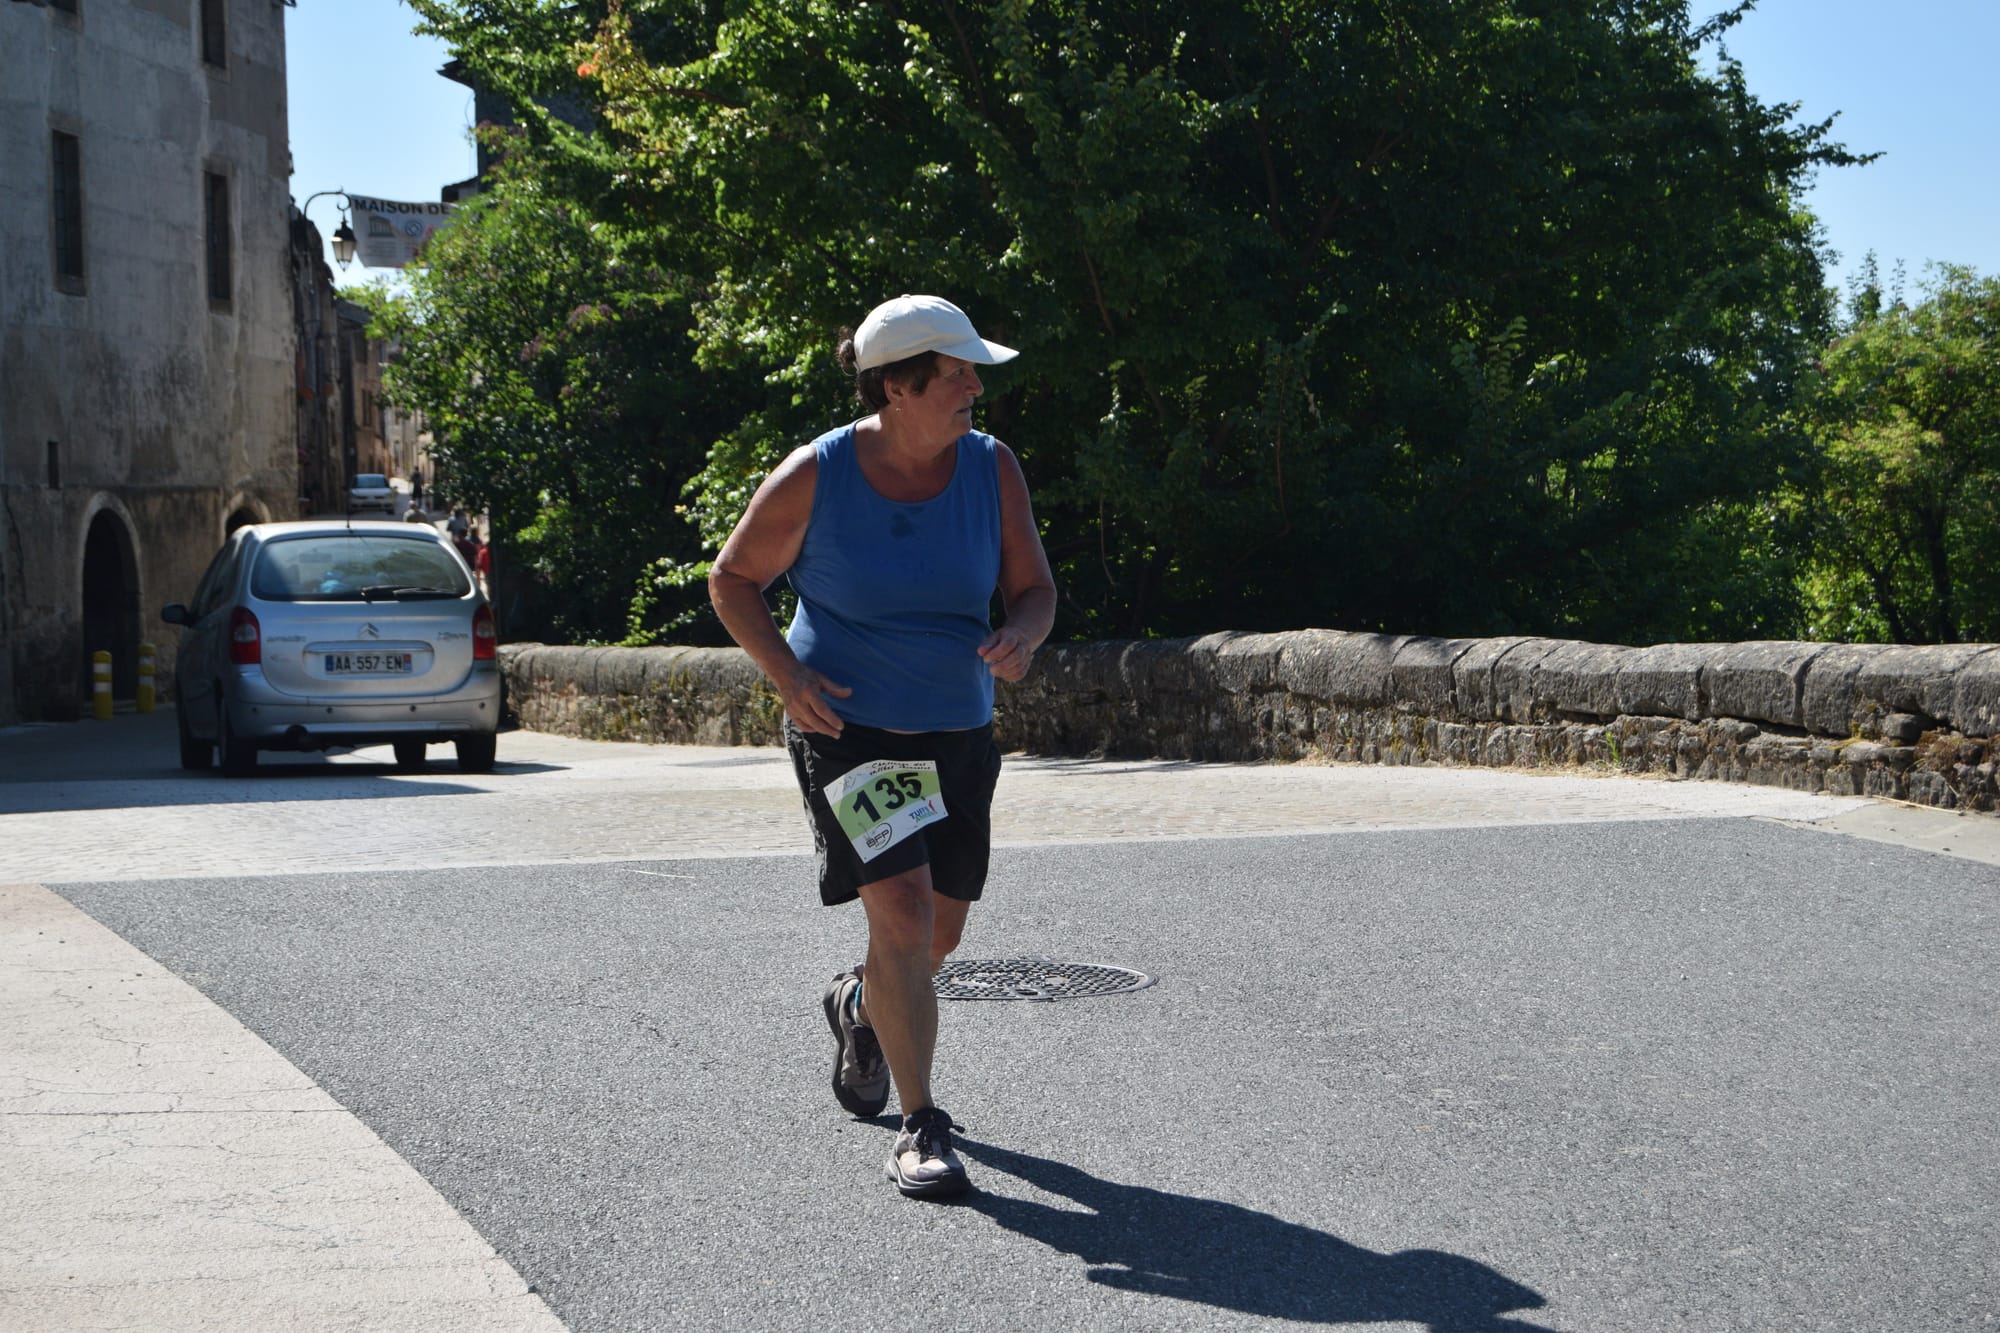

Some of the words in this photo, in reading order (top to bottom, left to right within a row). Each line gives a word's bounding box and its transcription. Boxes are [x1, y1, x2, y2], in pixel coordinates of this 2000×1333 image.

[355, 199, 423, 214] MAISON
[428, 203, 449, 215] DE
[852, 771, 922, 823] 135
